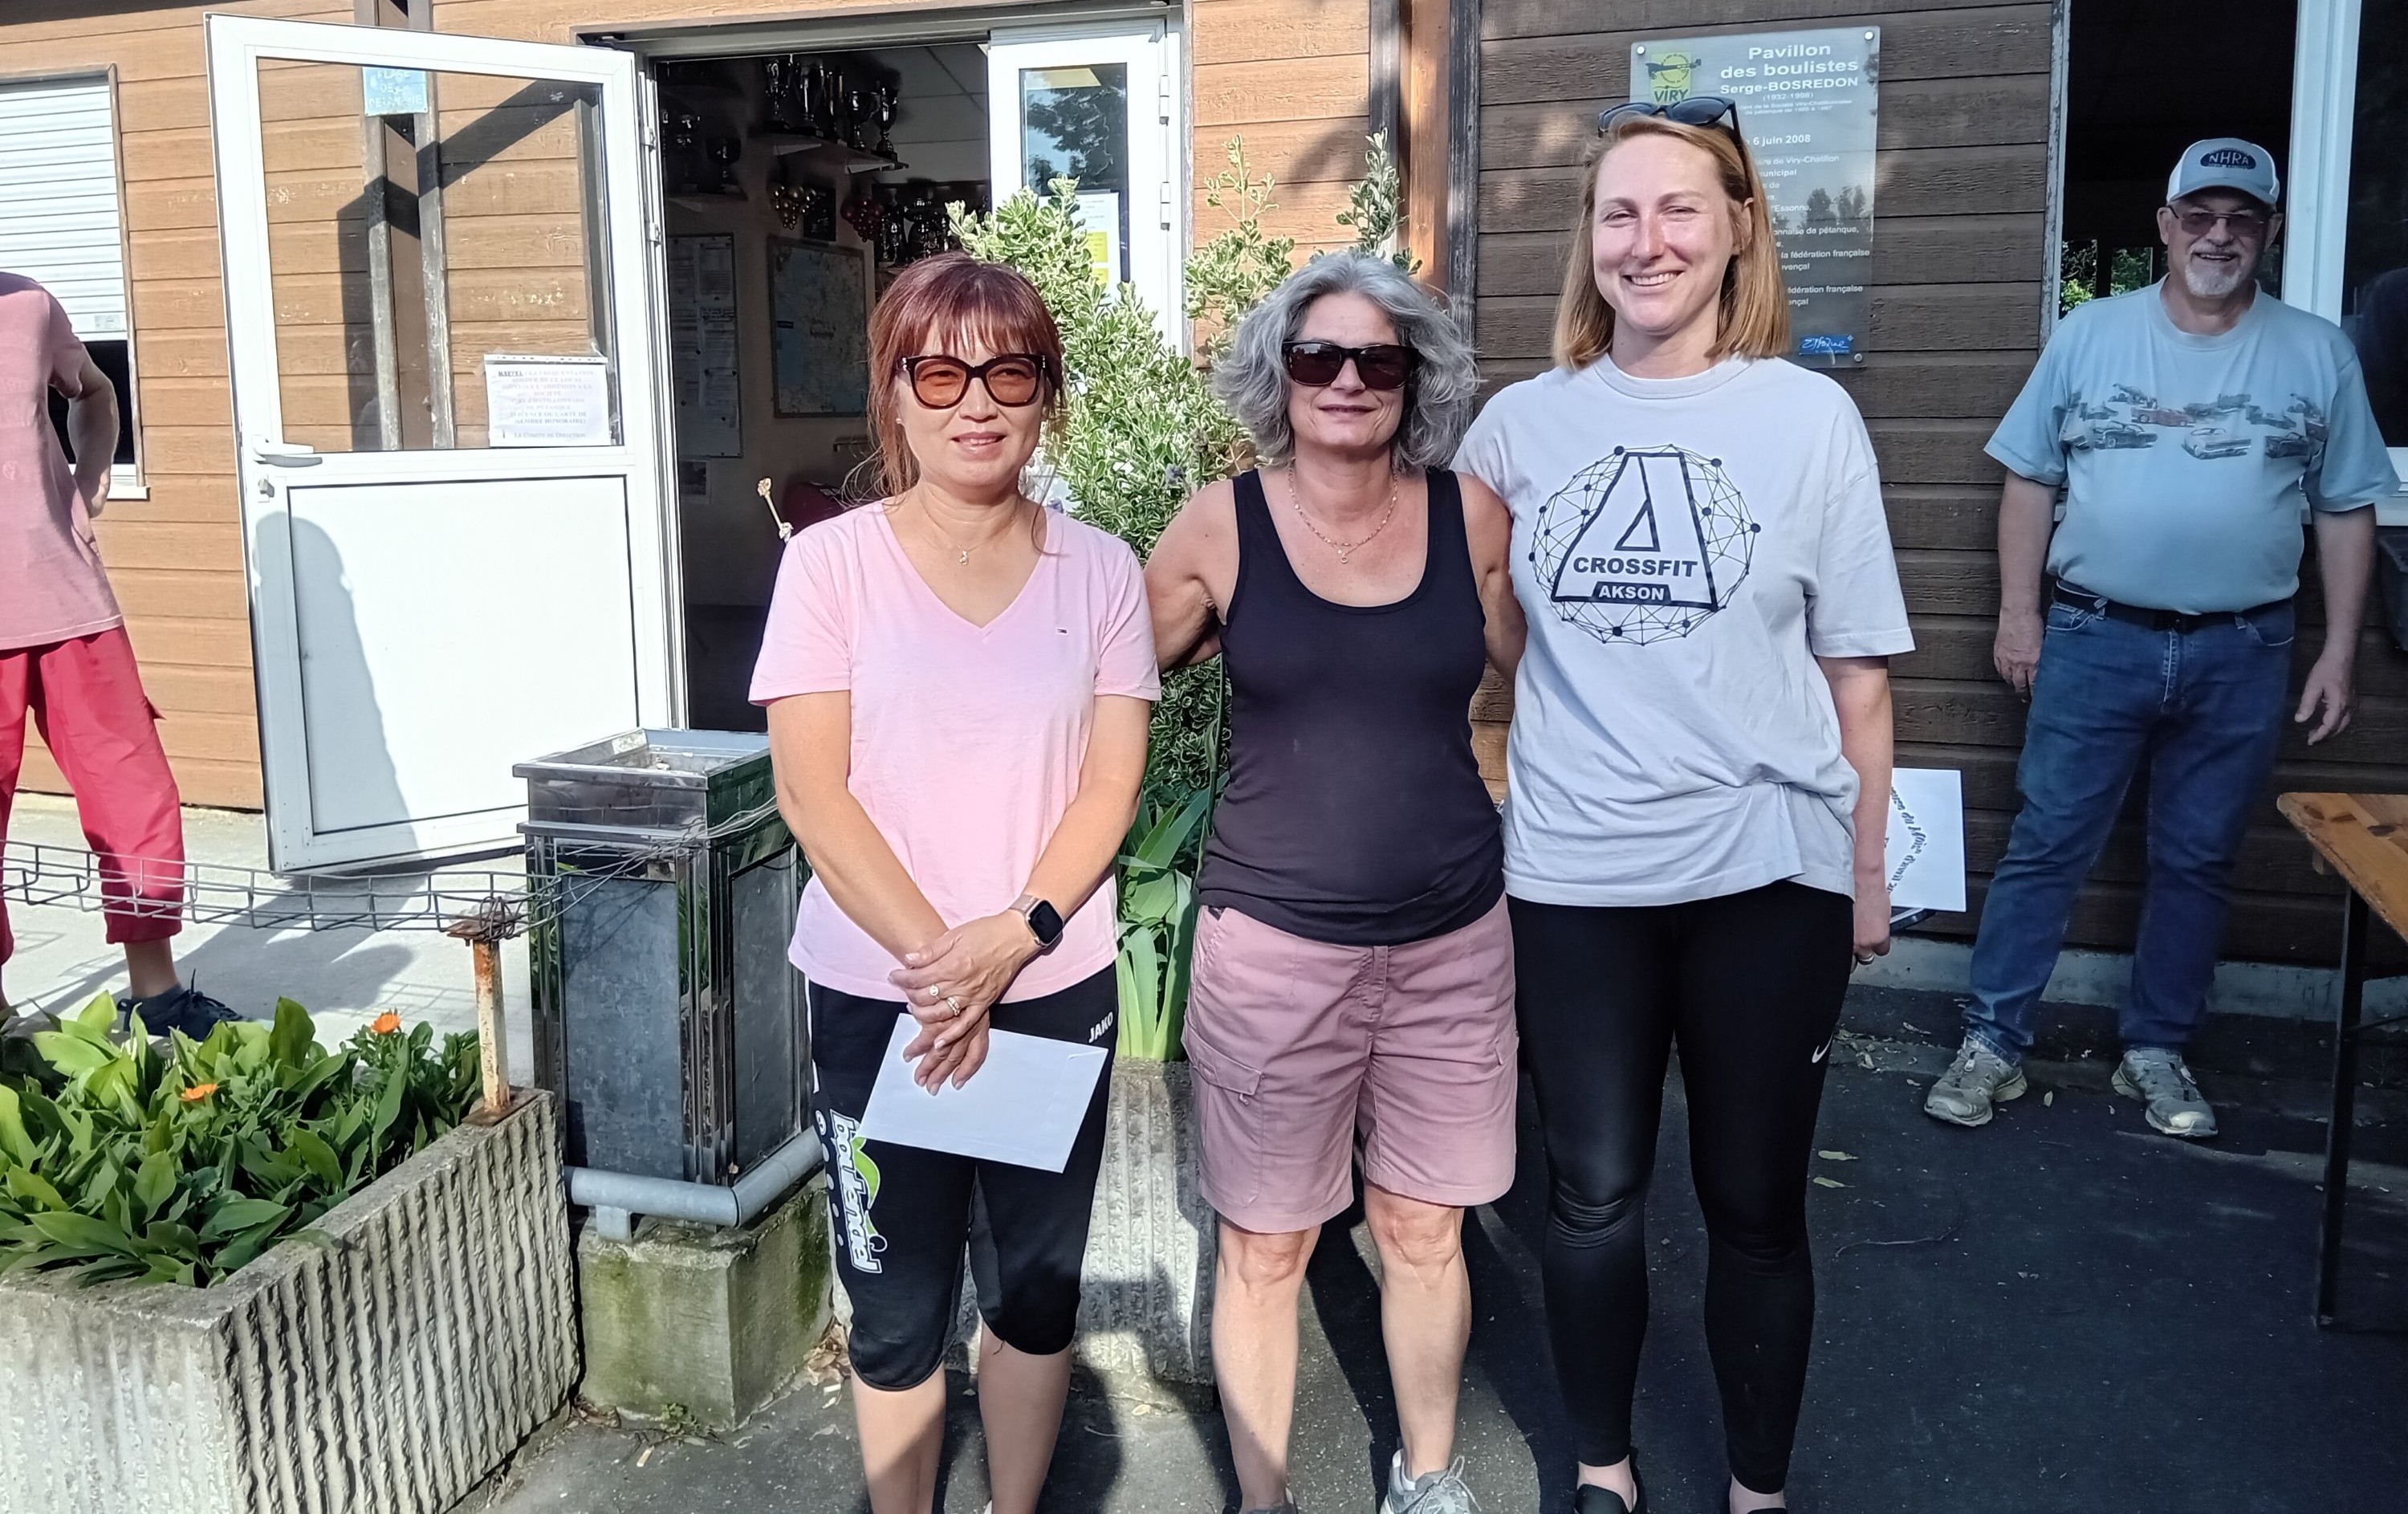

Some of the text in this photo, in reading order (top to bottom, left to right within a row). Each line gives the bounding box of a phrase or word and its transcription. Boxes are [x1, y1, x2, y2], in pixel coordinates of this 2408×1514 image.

[1748, 44, 1831, 60] Pavillon
[1720, 59, 1858, 79] des boulistes
[1720, 77, 1858, 95] Serge-BOSREDON
[1654, 88, 1689, 103] VIRY
[1753, 136, 1760, 145] 6
[1762, 136, 1783, 147] juin
[1785, 134, 1811, 144] 2008
[2209, 152, 2248, 165] NHRA
[1806, 226, 1816, 234] de
[1791, 250, 1830, 258] fédération
[1832, 249, 1870, 258] française
[1826, 284, 1863, 294] française
[1572, 556, 1698, 577] CROSSFIT
[1598, 584, 1665, 600] AKSON
[1088, 1011, 1113, 1043] JAKO
